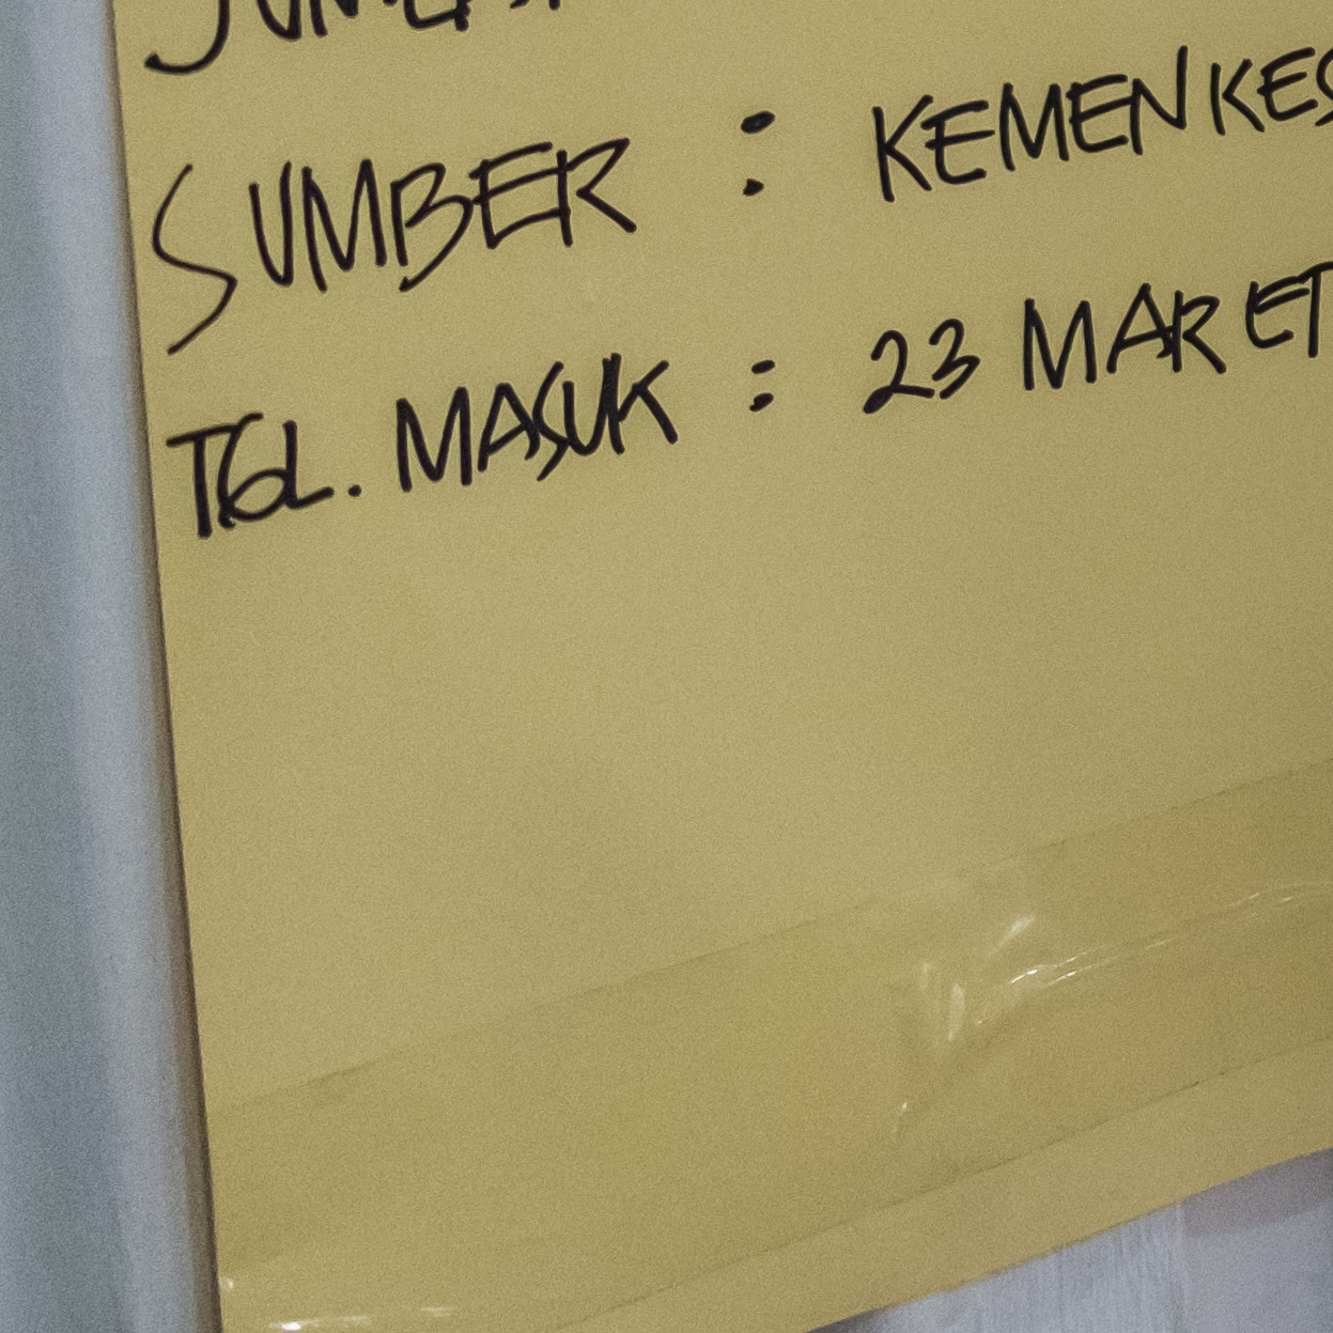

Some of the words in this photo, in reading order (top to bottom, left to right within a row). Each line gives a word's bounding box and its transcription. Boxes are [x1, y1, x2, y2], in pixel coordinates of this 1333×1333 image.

[150, 136, 639, 357] SUMBER
[164, 411, 364, 540] TGL.
[394, 351, 679, 494] MASUK
[861, 317, 982, 416] 23
